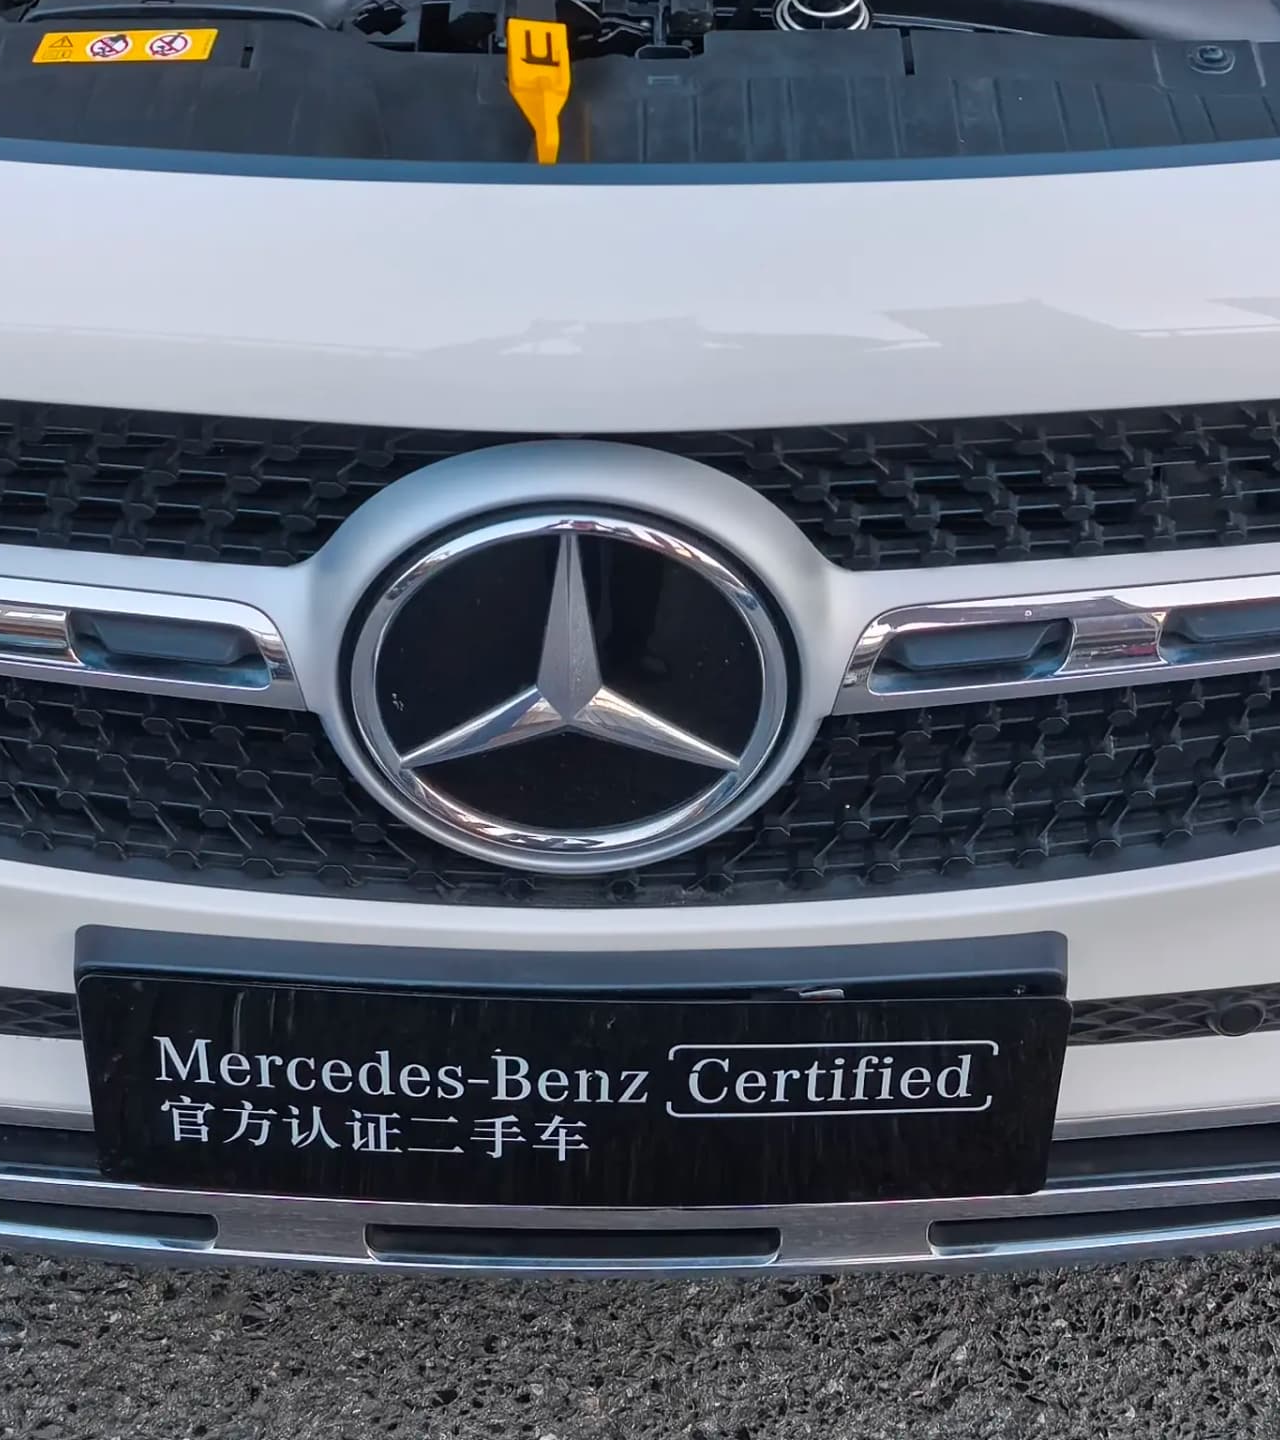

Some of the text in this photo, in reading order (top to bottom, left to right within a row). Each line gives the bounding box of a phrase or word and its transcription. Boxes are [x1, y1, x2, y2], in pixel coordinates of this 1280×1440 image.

[153, 1036, 973, 1105] Mercedes-Benz Certified
[160, 1095, 590, 1162] 官方认证二手车
